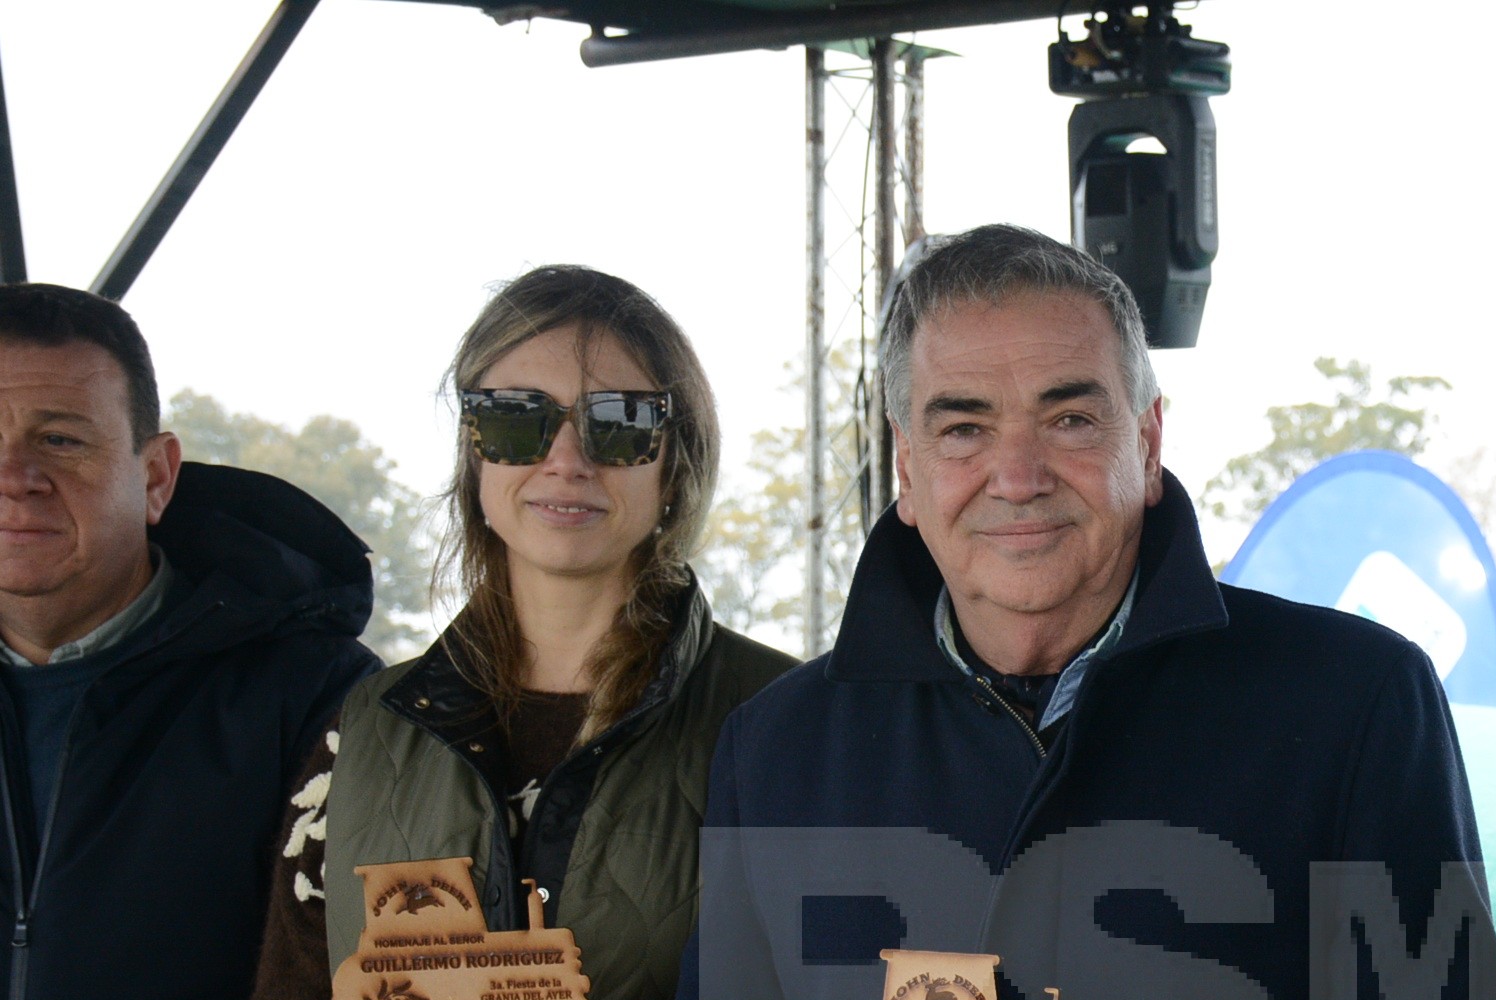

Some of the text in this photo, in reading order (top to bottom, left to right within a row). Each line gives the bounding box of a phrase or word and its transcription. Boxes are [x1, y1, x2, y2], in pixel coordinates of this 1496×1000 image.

[373, 879, 472, 916] JOHN DEERE
[374, 934, 485, 948] HOMENAJE AL SEÑOR
[361, 951, 565, 973] GUILLERMO RODRIGUEZ
[490, 978, 561, 990] 3a. Fiesta de la
[523, 992, 544, 1000] DEL
[546, 990, 573, 1000] AYER
